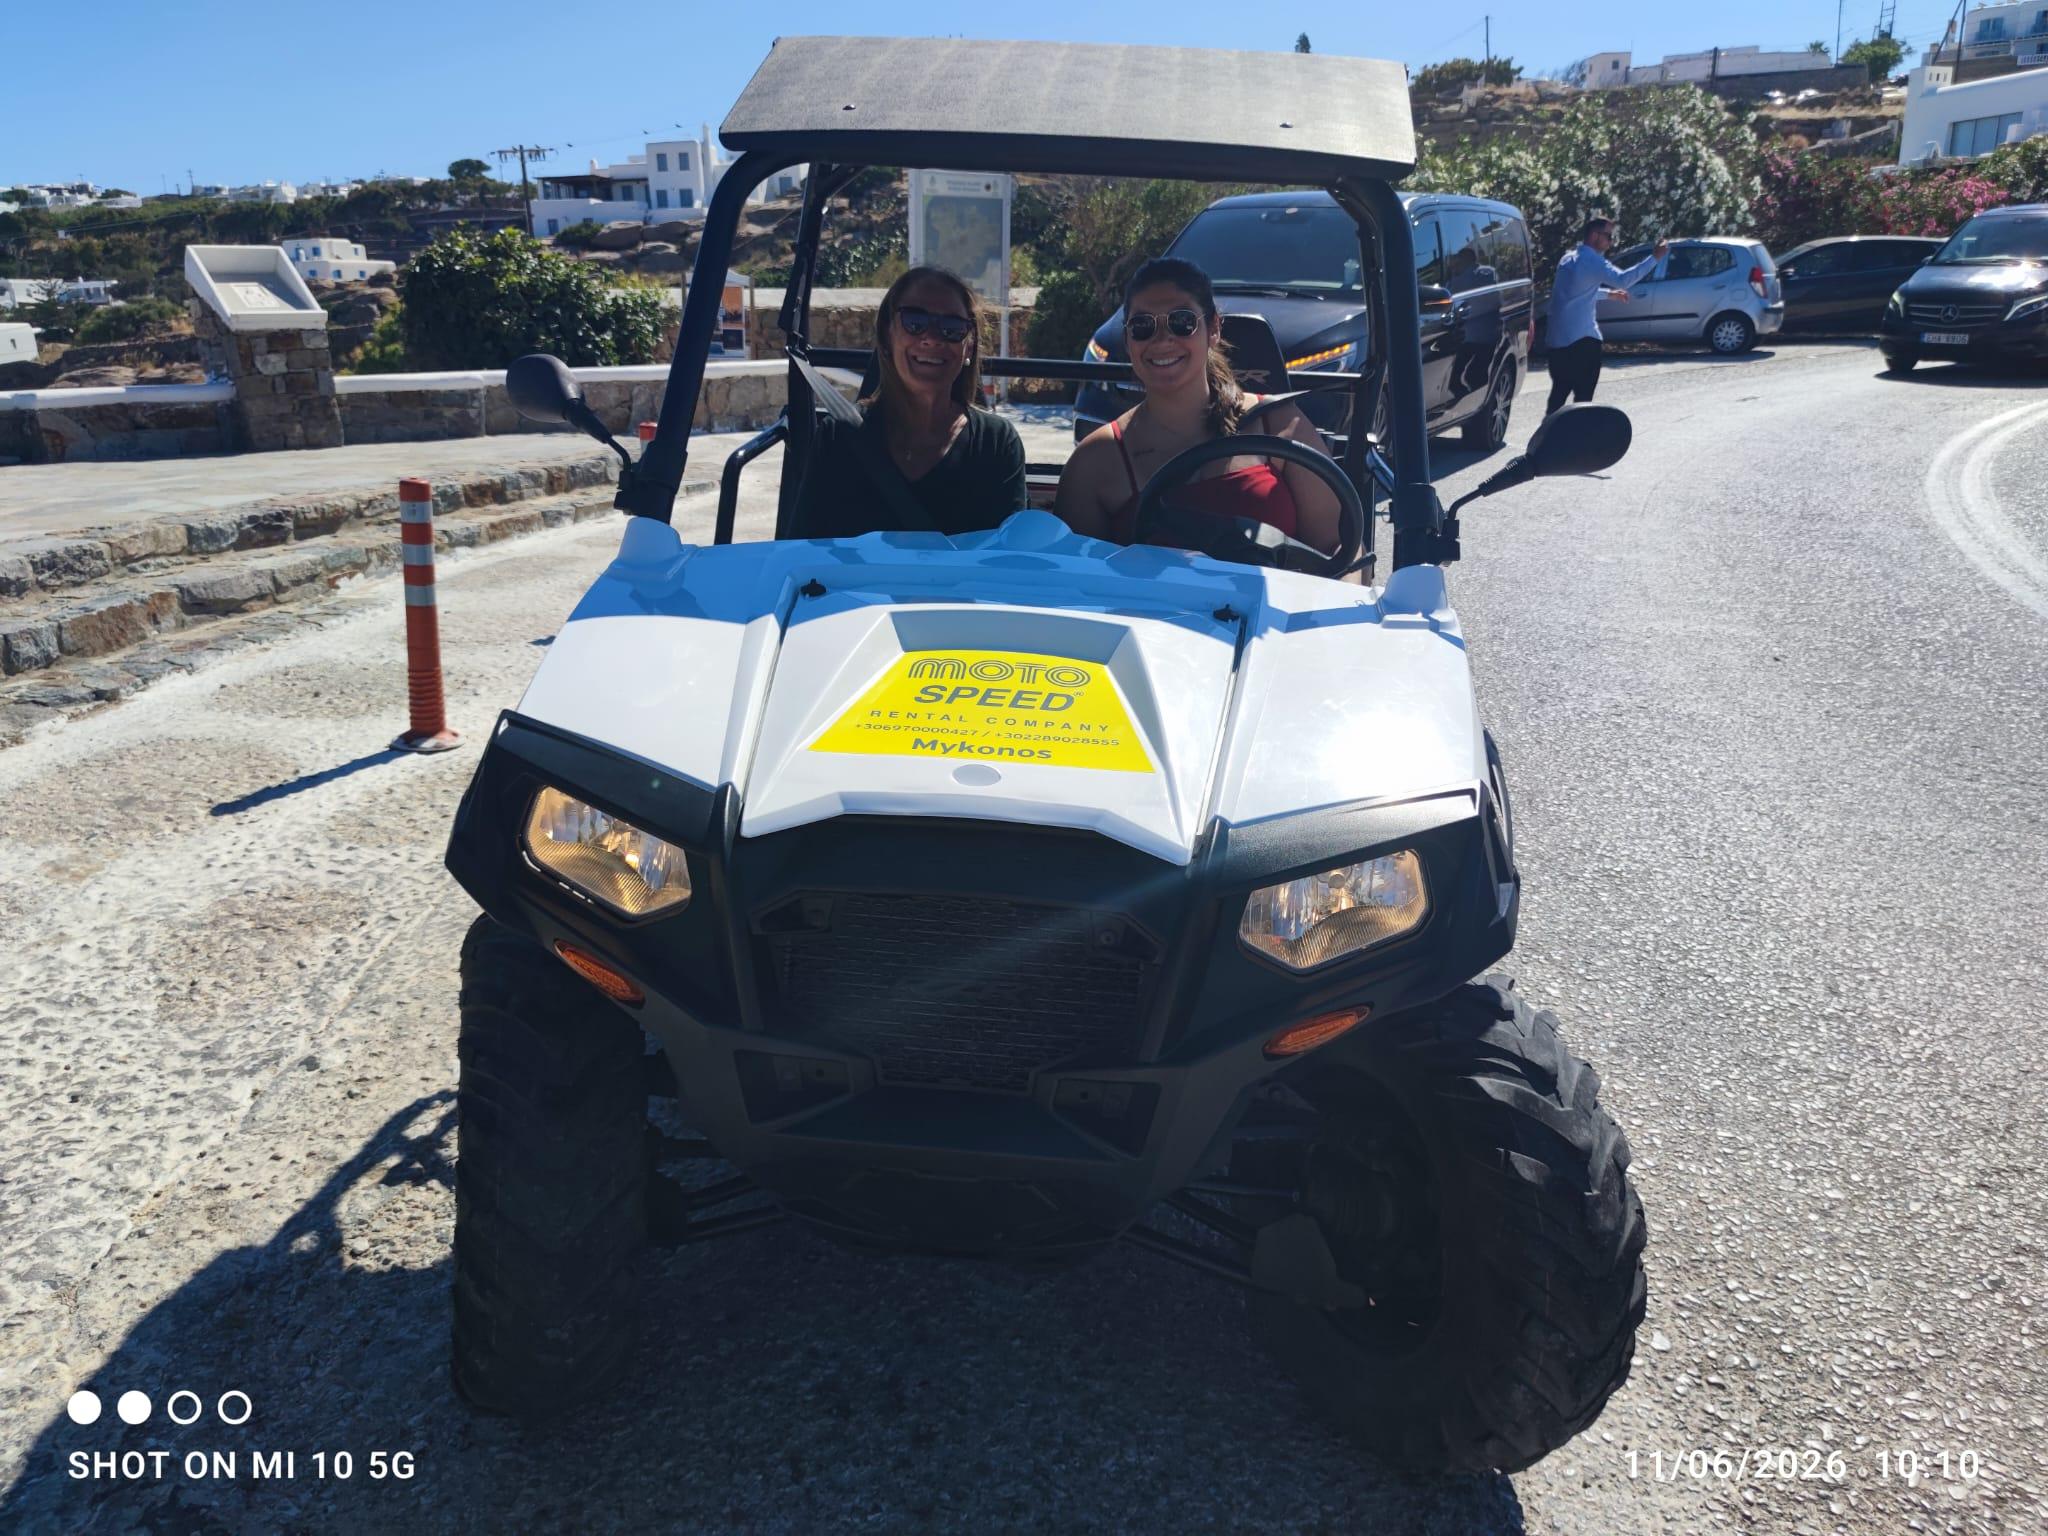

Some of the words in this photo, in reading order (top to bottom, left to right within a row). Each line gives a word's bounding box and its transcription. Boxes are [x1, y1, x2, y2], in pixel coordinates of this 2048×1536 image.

[907, 657, 1091, 688] MOTO
[914, 684, 1074, 713] SPEED
[870, 710, 969, 723] RENTAL
[986, 716, 1110, 732] COMPANY
[911, 738, 1053, 760] Mykonos
